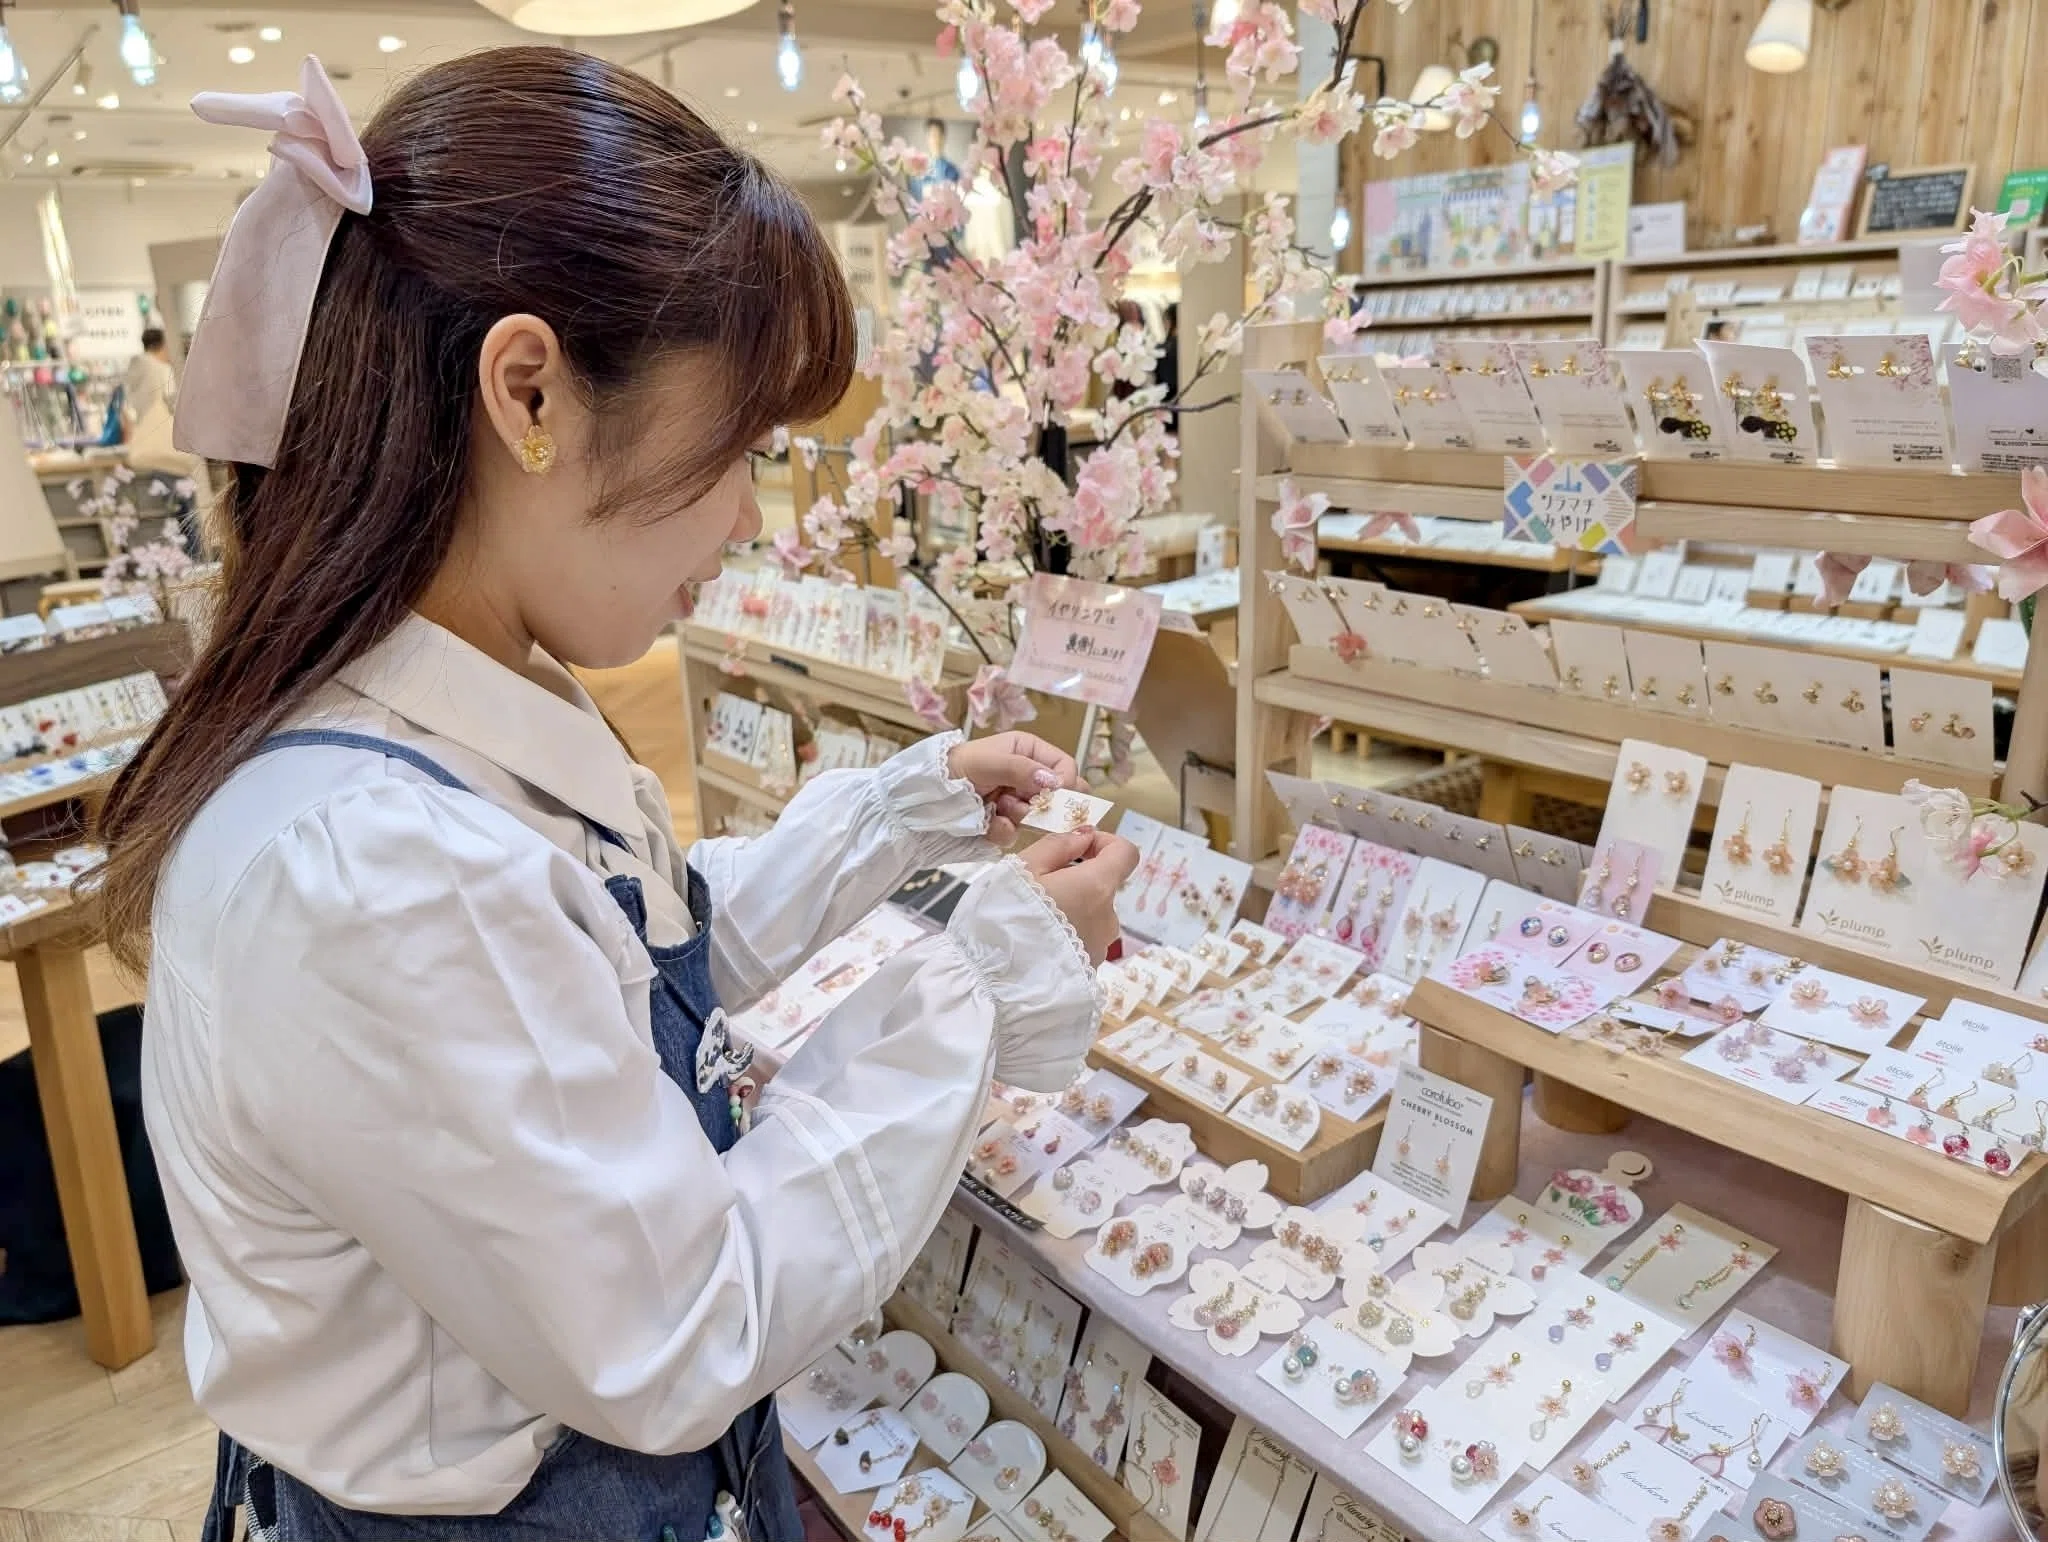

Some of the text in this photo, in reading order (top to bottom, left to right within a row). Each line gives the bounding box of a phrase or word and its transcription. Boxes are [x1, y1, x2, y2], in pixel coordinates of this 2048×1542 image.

[1734, 887, 1776, 907] plump
[1839, 917, 1886, 938] plump
[1943, 946, 1995, 970] plump
[1400, 1098, 1432, 1118] CHERRY
[1434, 1113, 1474, 1137] BLOSSOM
